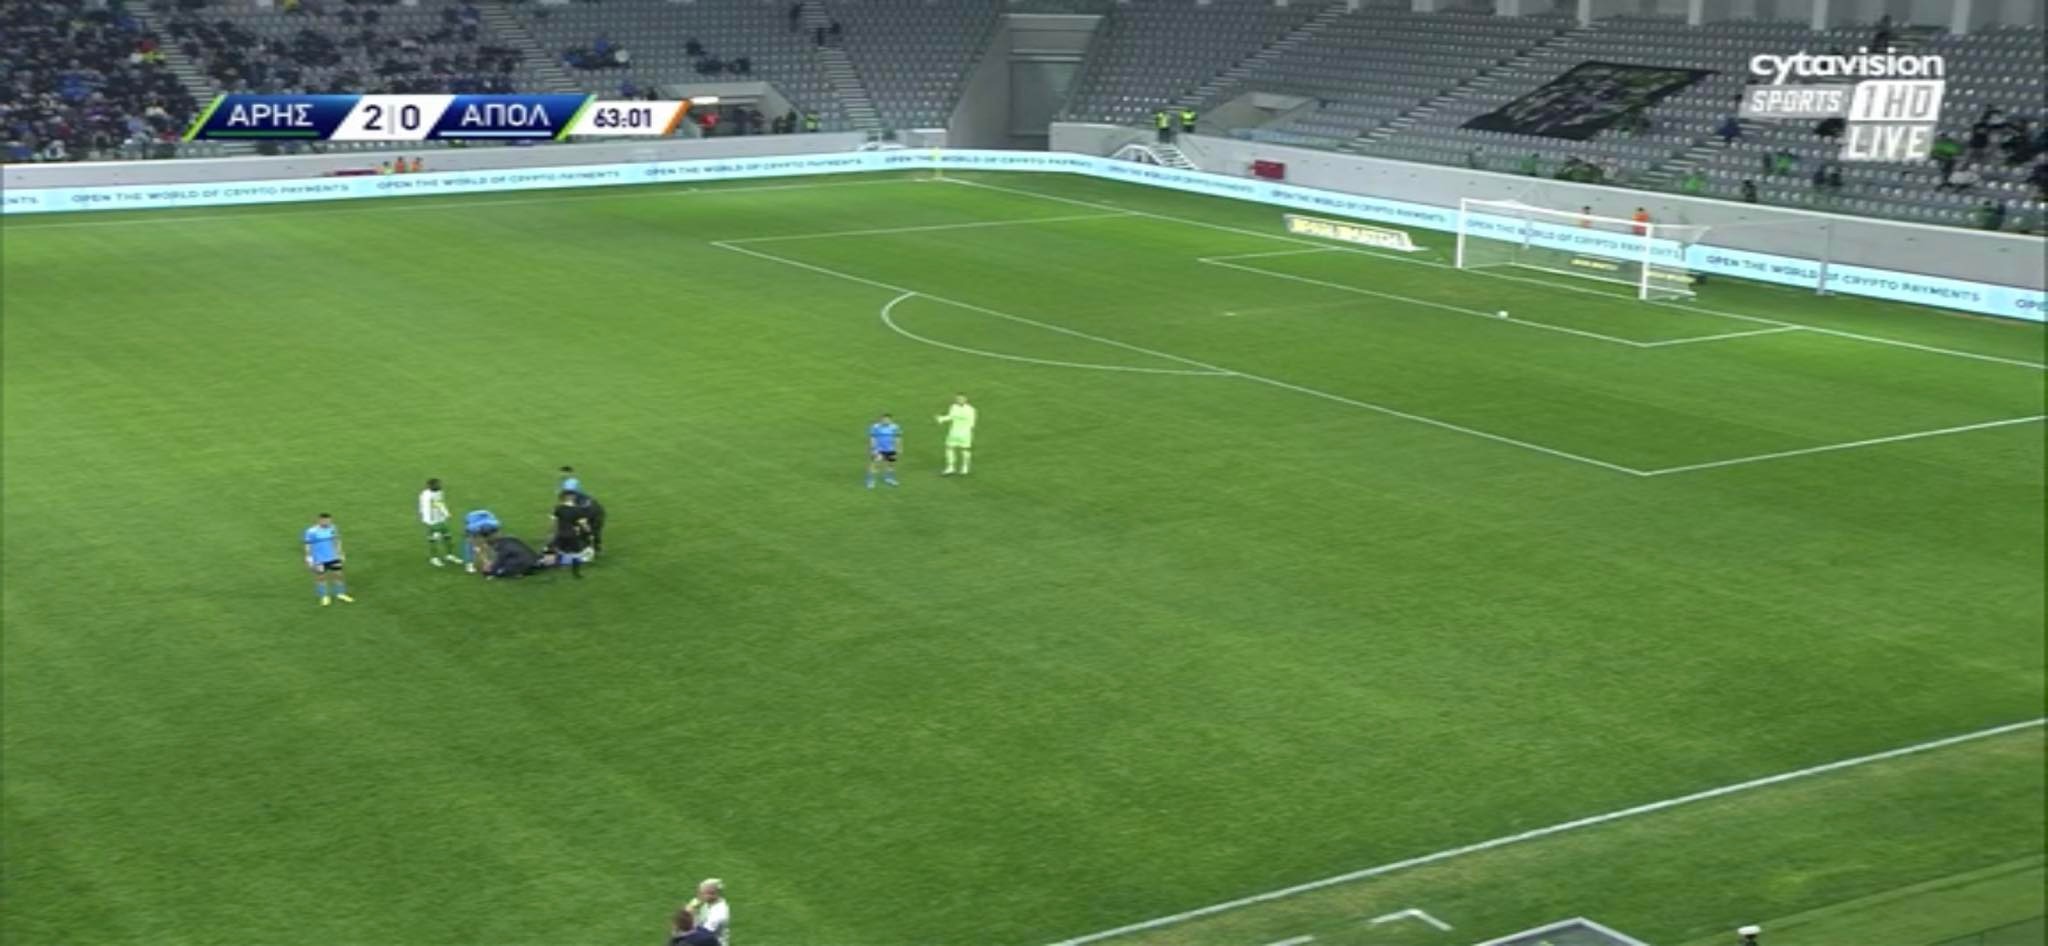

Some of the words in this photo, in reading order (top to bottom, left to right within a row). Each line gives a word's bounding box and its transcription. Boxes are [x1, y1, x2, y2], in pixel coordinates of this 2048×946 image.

[645, 168, 676, 176] OPEN
[704, 164, 744, 172] WORLD
[377, 180, 413, 190] OPEN
[415, 179, 438, 188] THE
[444, 176, 487, 186] WORLD
[491, 176, 508, 184] OF
[71, 193, 111, 204] OPEN
[116, 192, 142, 201] THE
[148, 189, 200, 200] WORLD
[202, 188, 220, 198] OF
[223, 186, 275, 198] CRYPTO
[1706, 254, 1739, 268] OPEN
[1744, 259, 1765, 272] THE
[1772, 263, 1818, 279] WORLD
[1842, 274, 1900, 291] CRYPTO
[1901, 282, 1981, 302] PAYMENTS
